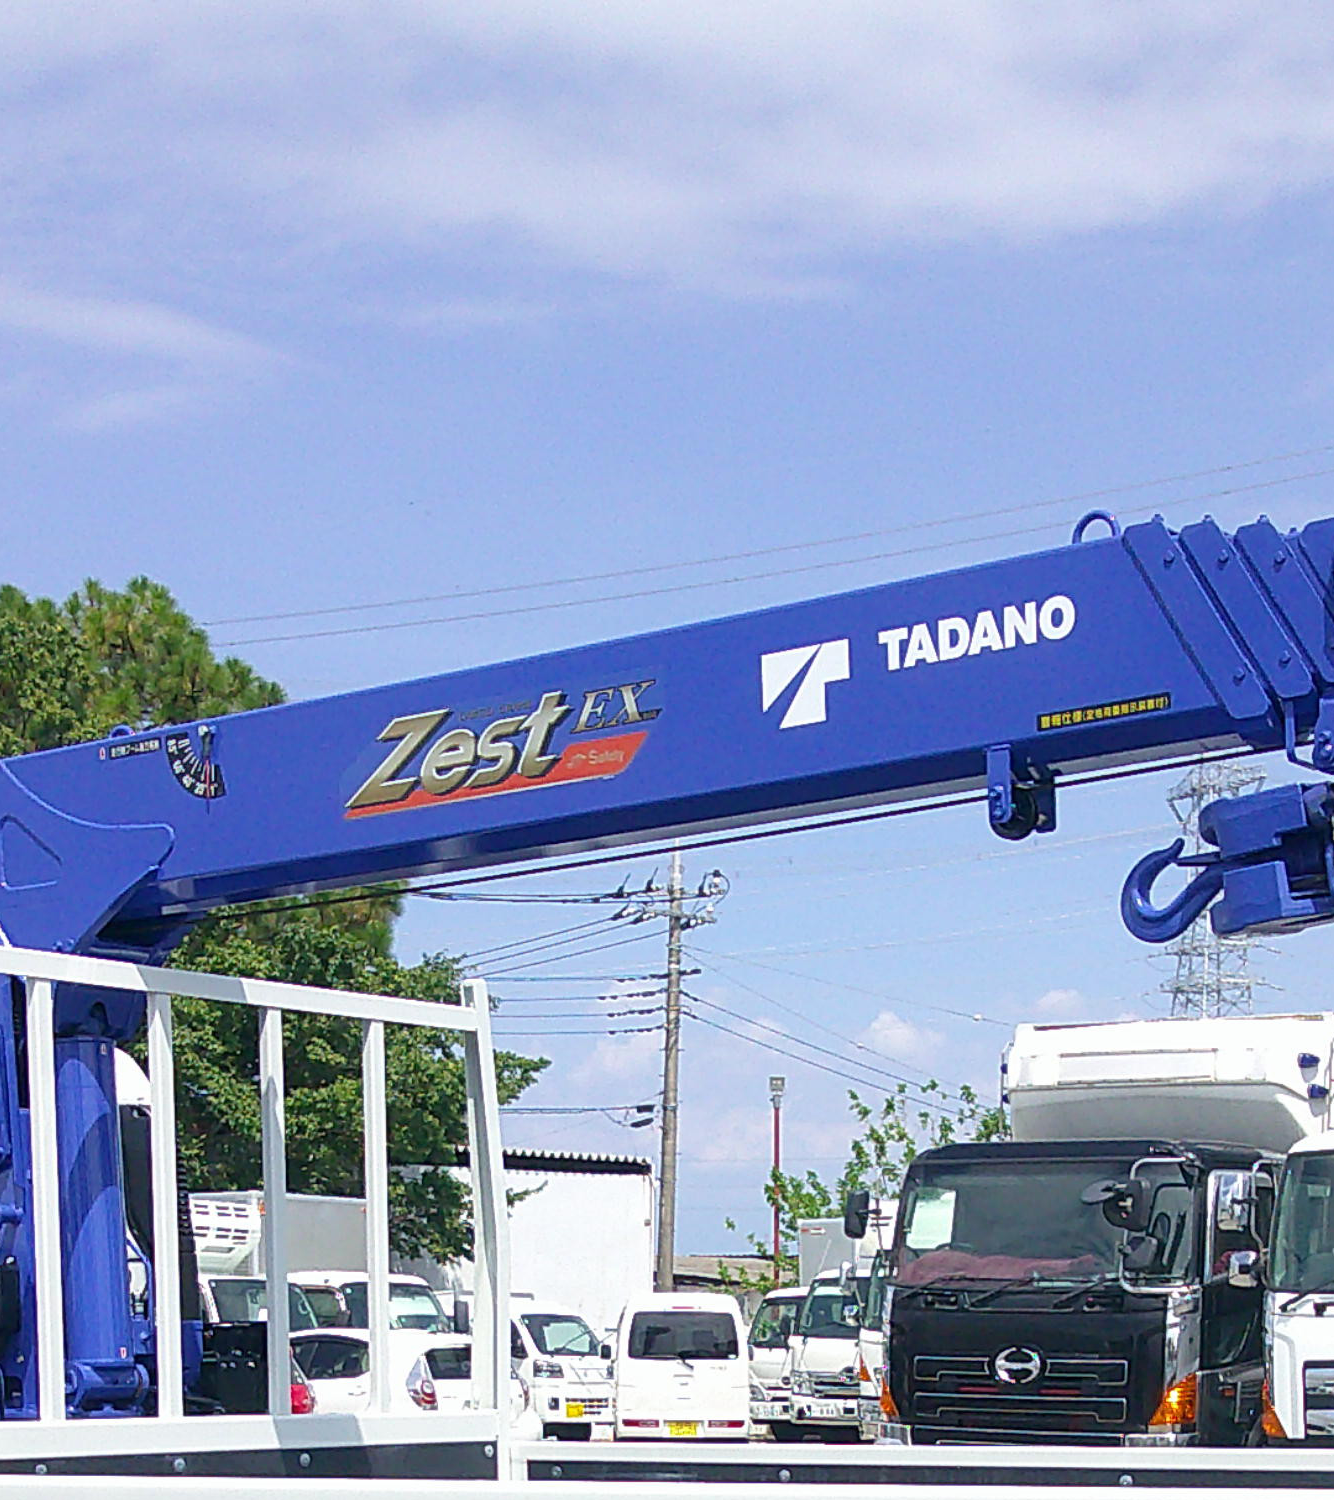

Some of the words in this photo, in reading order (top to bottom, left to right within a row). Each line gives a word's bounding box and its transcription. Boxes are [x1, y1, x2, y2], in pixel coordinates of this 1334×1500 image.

[877, 595, 1076, 671] TADANO
[344, 690, 574, 808] Zest
[570, 680, 656, 734] EX
